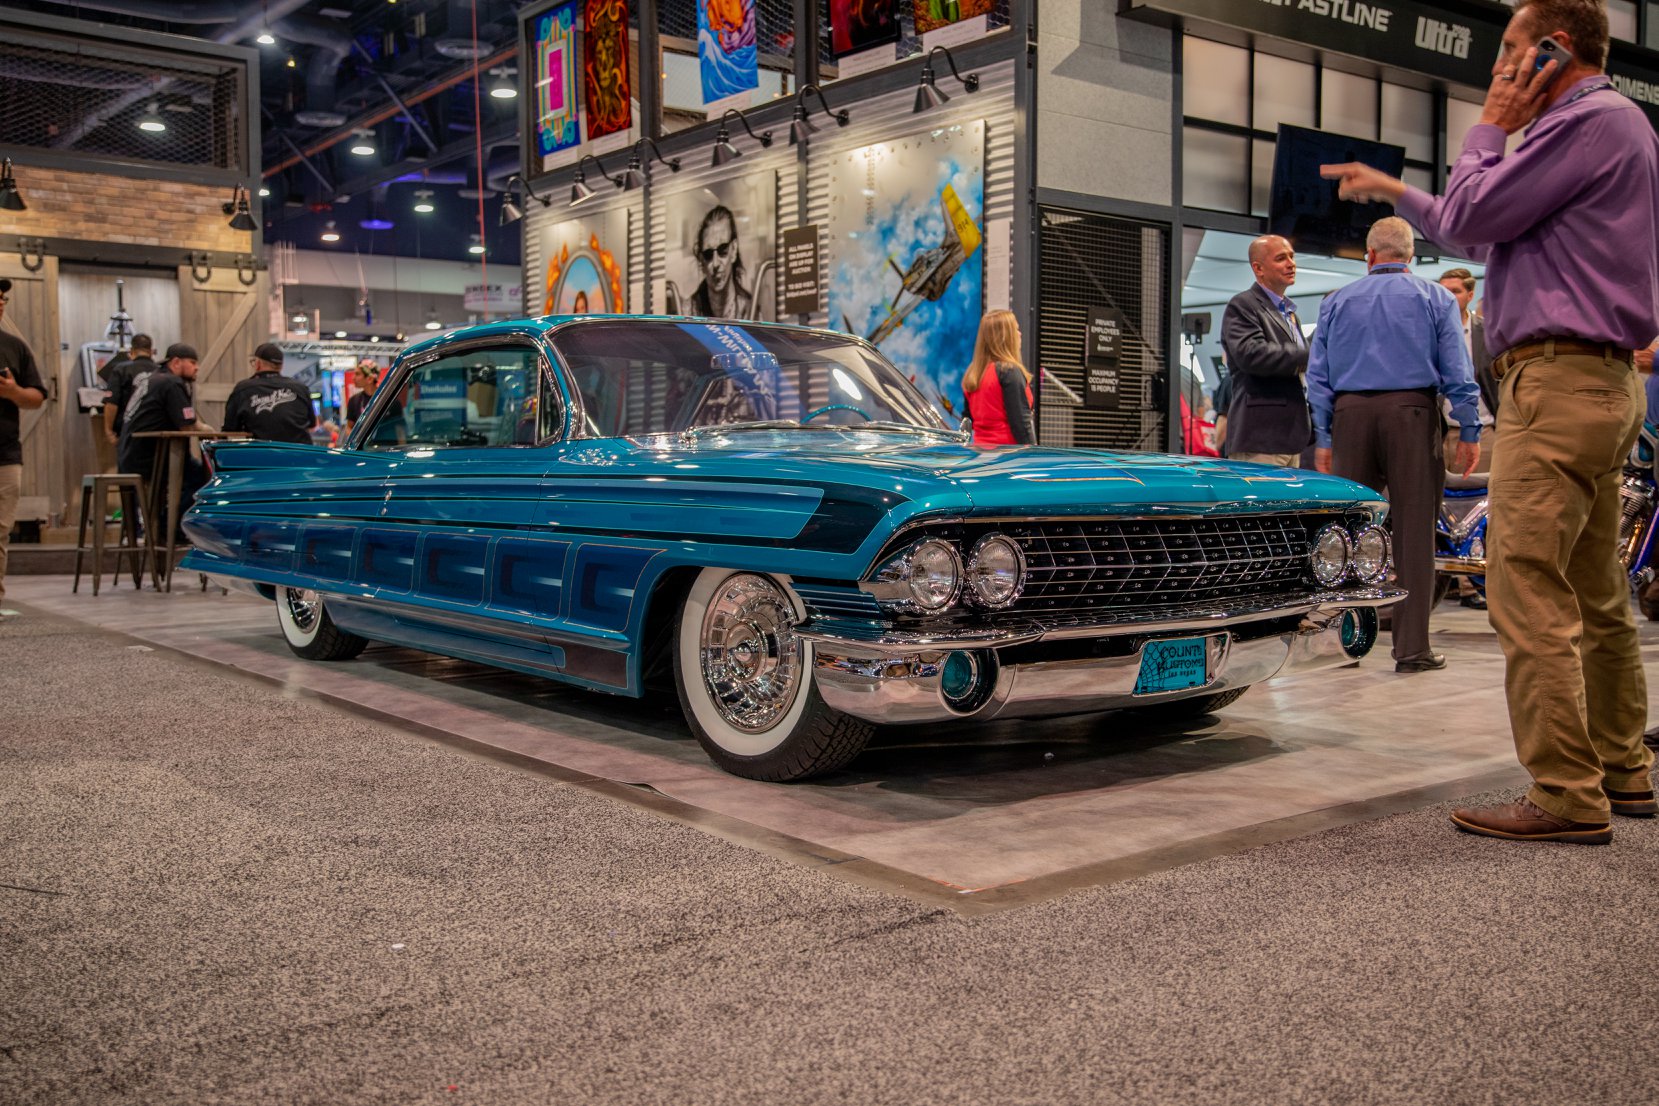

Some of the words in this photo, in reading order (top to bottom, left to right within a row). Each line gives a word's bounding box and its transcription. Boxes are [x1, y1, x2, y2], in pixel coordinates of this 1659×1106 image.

[1415, 16, 1469, 59] Ultra
[1091, 326, 1119, 335] EMPLOYEES
[1088, 377, 1118, 385] OCCUPANCY
